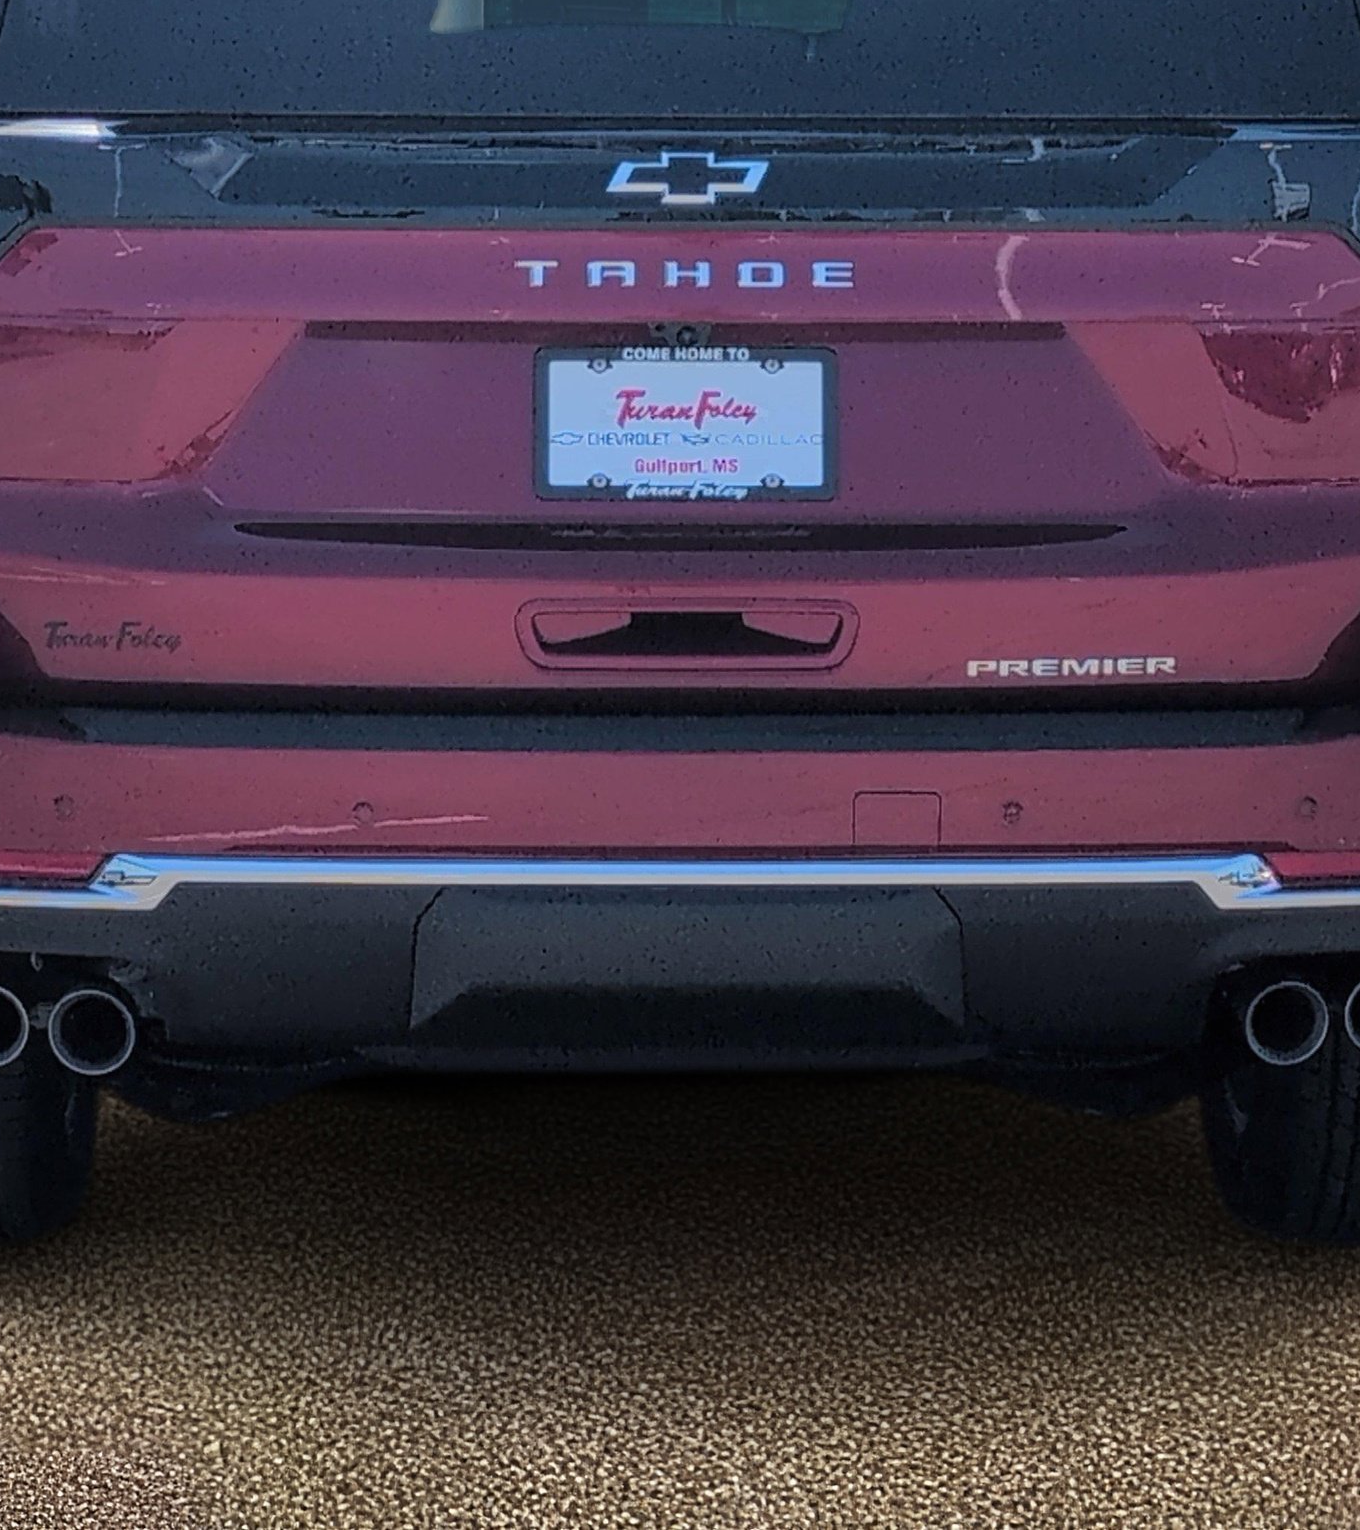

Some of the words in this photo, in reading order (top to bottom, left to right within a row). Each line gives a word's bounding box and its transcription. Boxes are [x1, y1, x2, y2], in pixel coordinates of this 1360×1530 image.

[514, 260, 855, 288] TAHOE
[622, 347, 671, 361] COME
[675, 347, 723, 361] HOME
[726, 347, 751, 361] TO
[616, 389, 693, 429] Turan
[694, 391, 757, 429] Foley
[588, 432, 671, 446] CHEVROLET
[715, 433, 823, 446] CADILLAC
[713, 458, 739, 473] MS
[966, 657, 1177, 678] PREMIER
